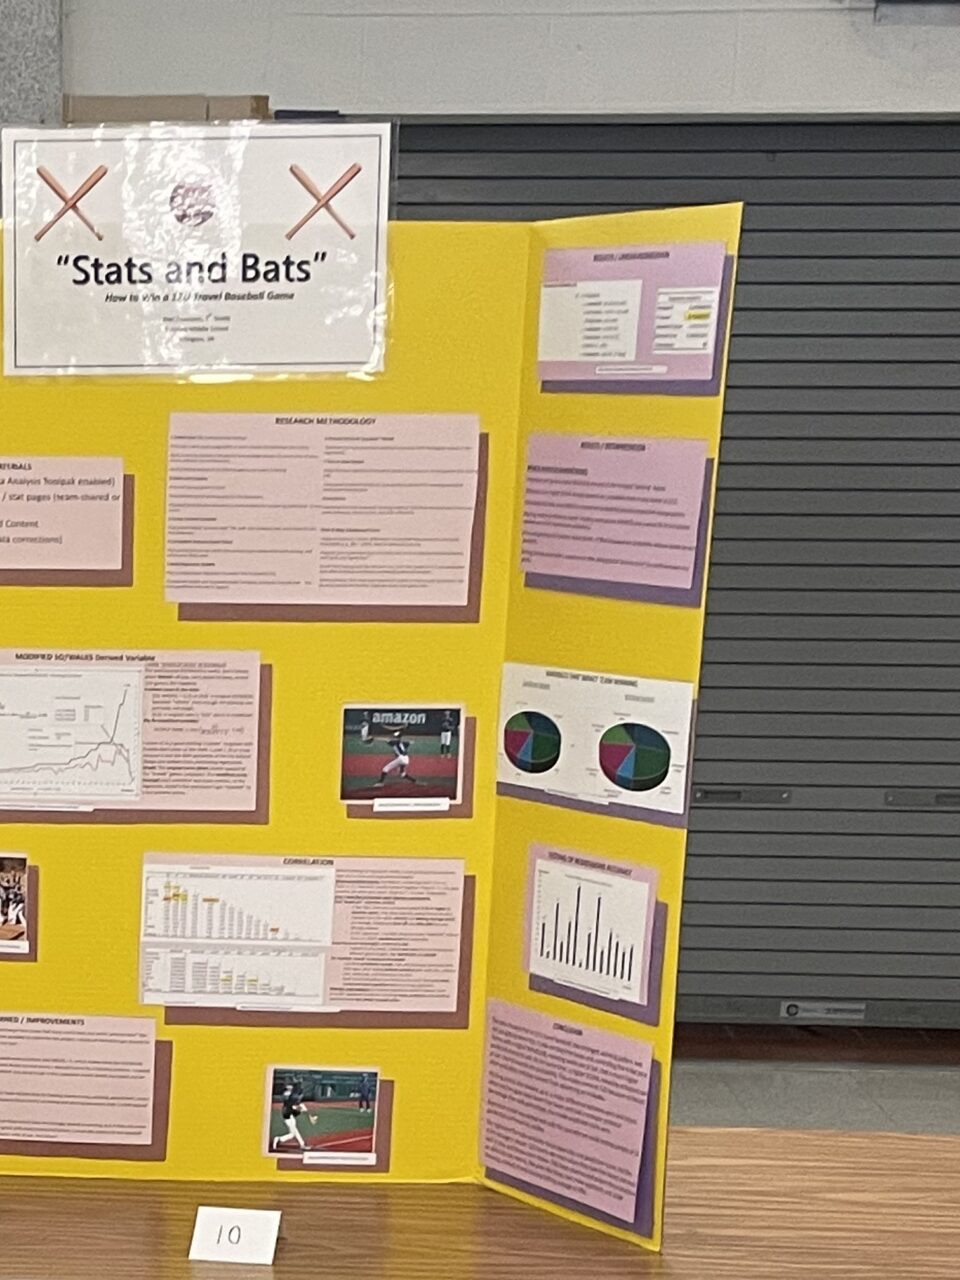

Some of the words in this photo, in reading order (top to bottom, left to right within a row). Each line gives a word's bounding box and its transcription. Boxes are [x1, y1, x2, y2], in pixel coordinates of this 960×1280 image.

[165, 253, 227, 284] and
[105, 293, 127, 302] How
[129, 293, 139, 302] to
[225, 291, 265, 301] Baseball
[267, 291, 295, 300] Game
[275, 417, 314, 425] RESEARCH
[316, 417, 376, 425] METHODOLOGY
[9, 493, 24, 501] stat
[26, 494, 51, 502] pages
[5, 520, 39, 528] Content
[125, 654, 156, 662] Variable
[372, 711, 426, 724] amazon
[26, 1017, 85, 1026] IMPROVEMENTS
[217, 1225, 241, 1245] 10
